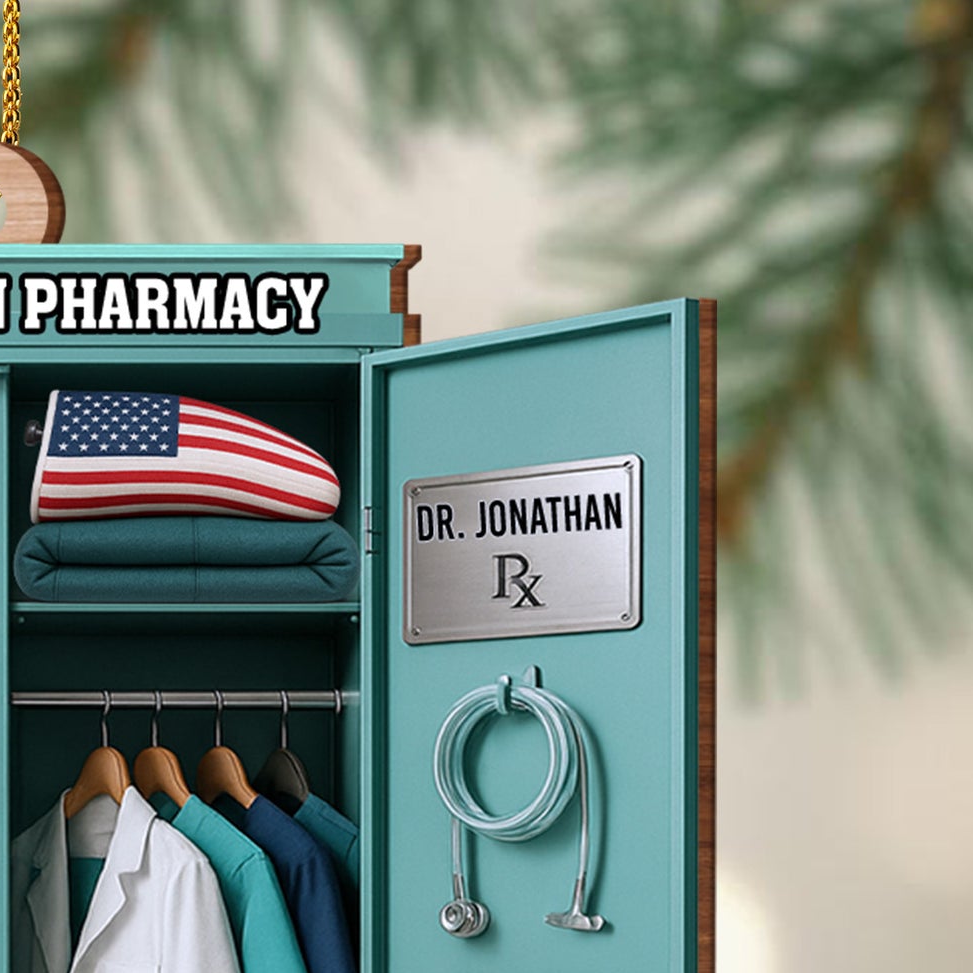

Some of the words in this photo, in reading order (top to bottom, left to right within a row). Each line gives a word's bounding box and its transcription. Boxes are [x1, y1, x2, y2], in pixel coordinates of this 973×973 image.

[22, 275, 326, 332] PHARMACY
[417, 503, 465, 541] DR.
[475, 492, 623, 538] JONATHAN
